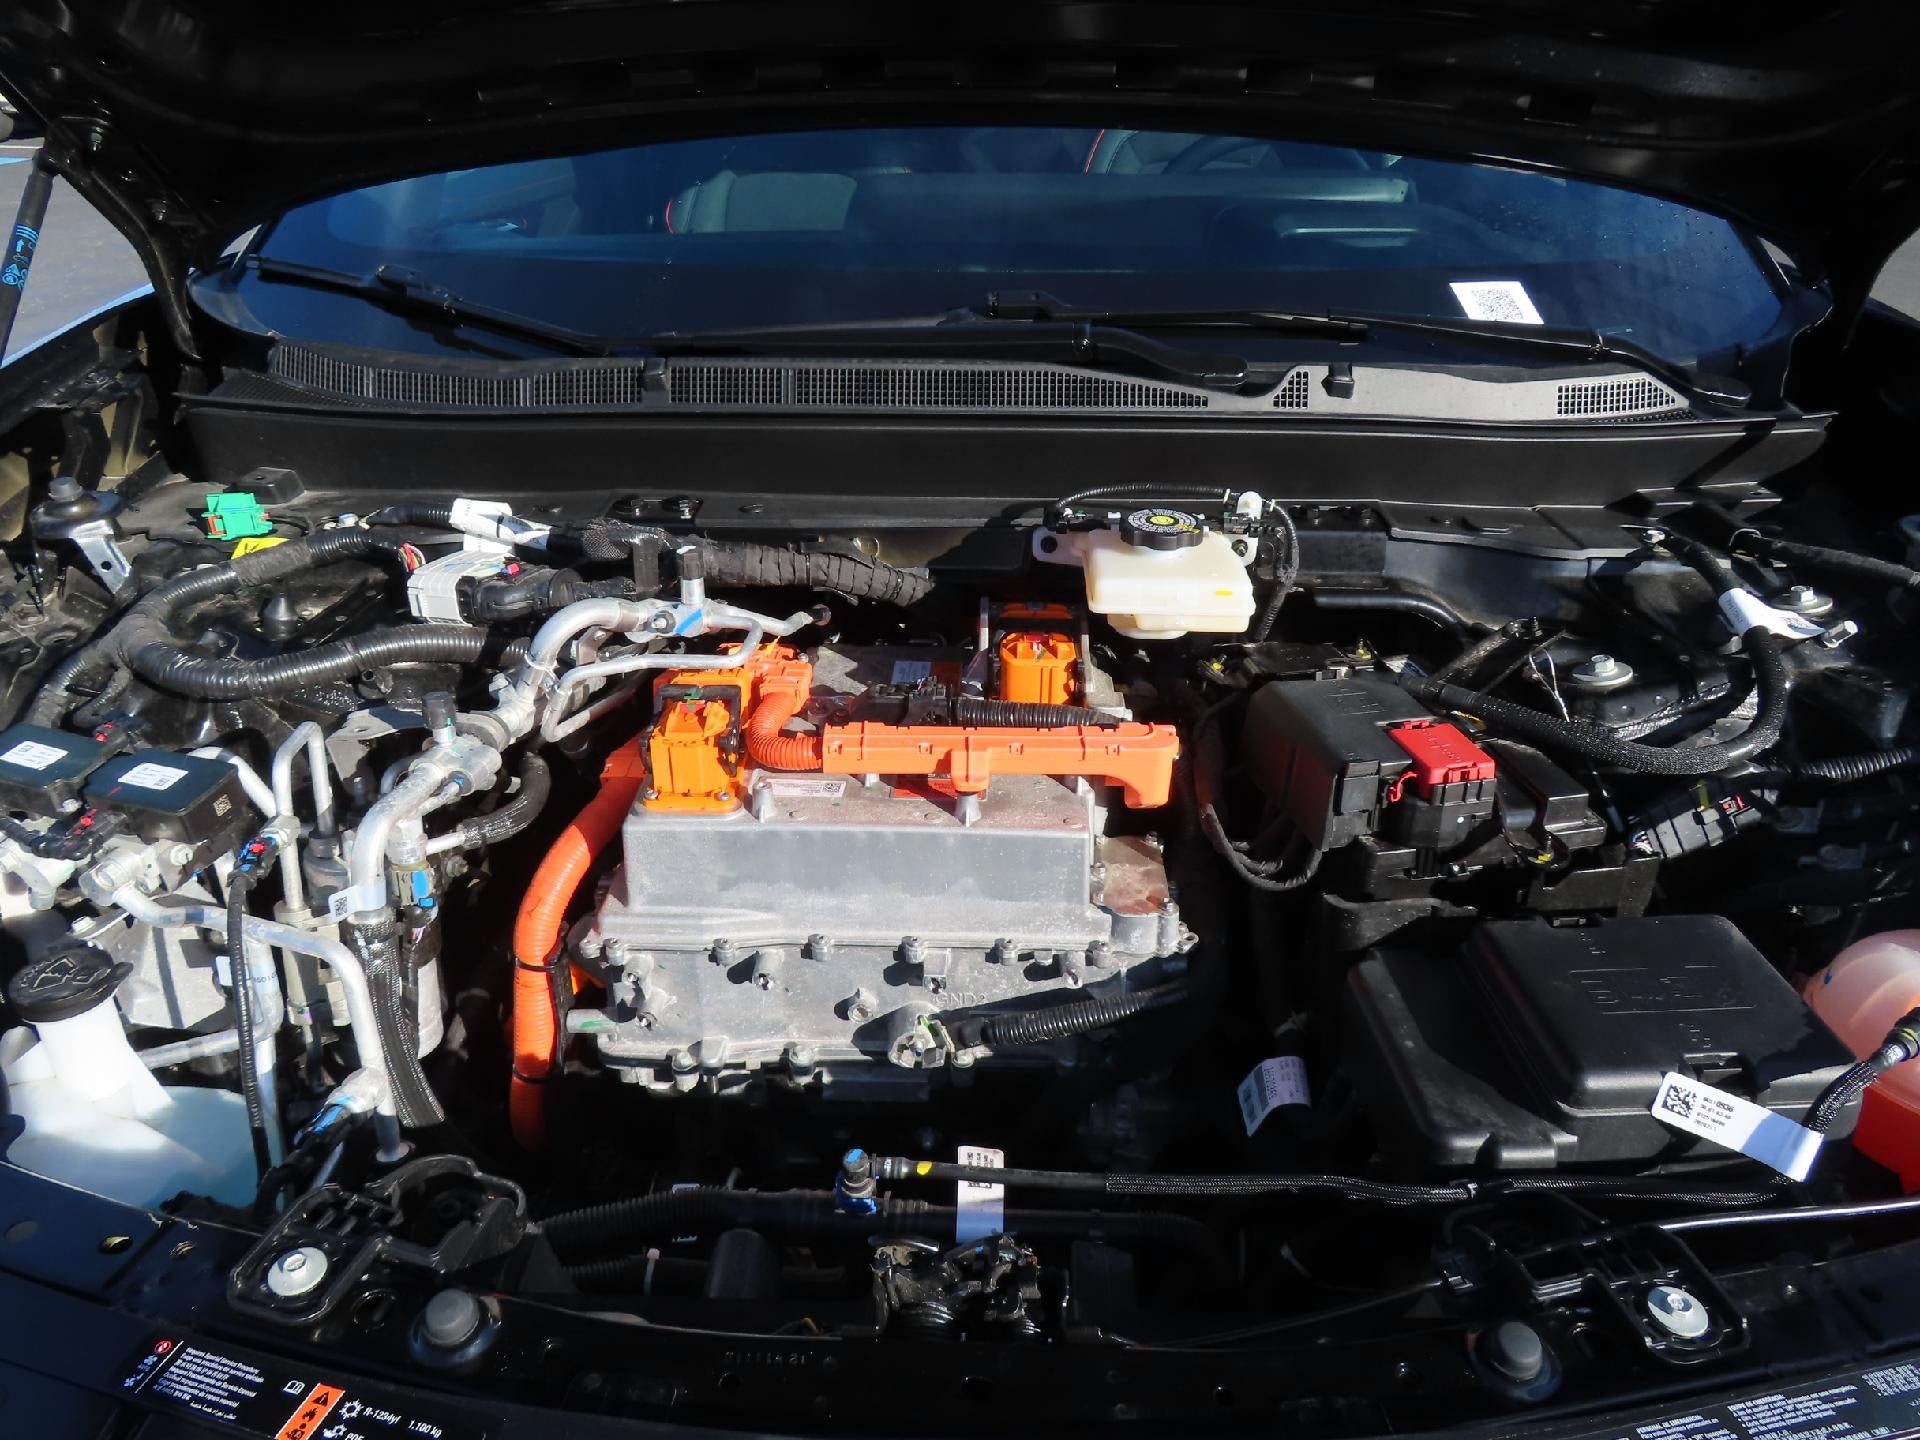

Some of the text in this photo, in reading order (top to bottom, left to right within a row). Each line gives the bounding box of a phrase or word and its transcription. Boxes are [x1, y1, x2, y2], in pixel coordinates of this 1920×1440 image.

[362, 1406, 443, 1439] R-1234yf 1.100 kg
